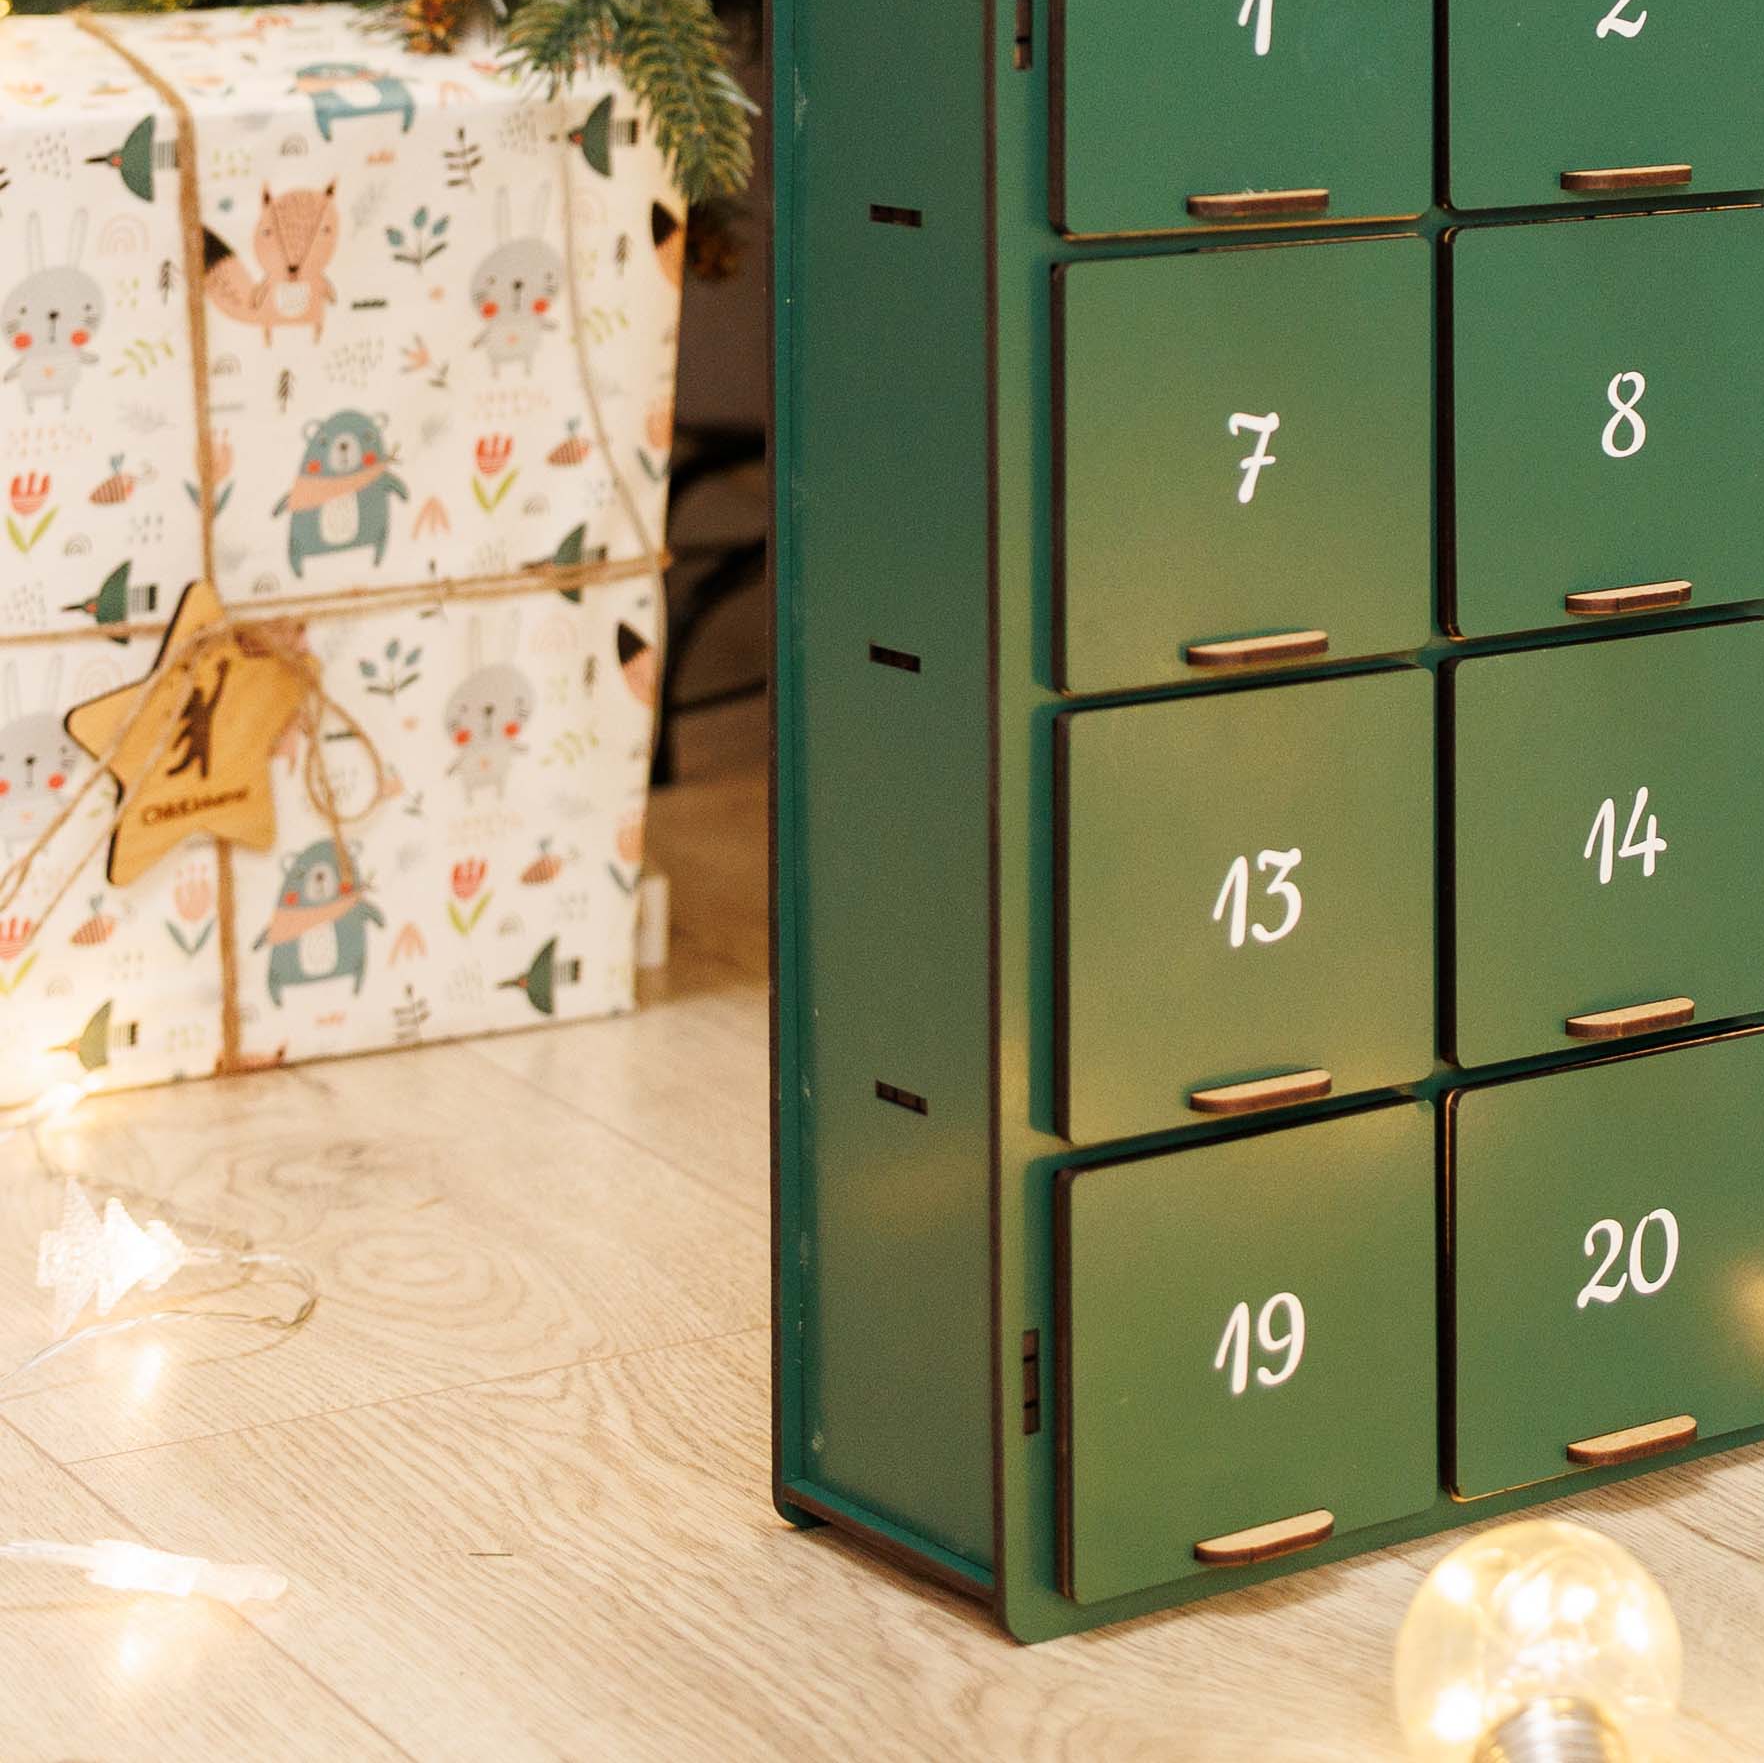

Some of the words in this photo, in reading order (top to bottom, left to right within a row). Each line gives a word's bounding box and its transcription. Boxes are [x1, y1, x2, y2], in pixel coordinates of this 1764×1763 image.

[1228, 412, 1280, 504] 7
[1601, 371, 1646, 458] 8
[1583, 786, 1668, 885] 14
[1212, 847, 1302, 948] 13
[1576, 1208, 1679, 1309] 20
[1214, 1292, 1305, 1395] 19
